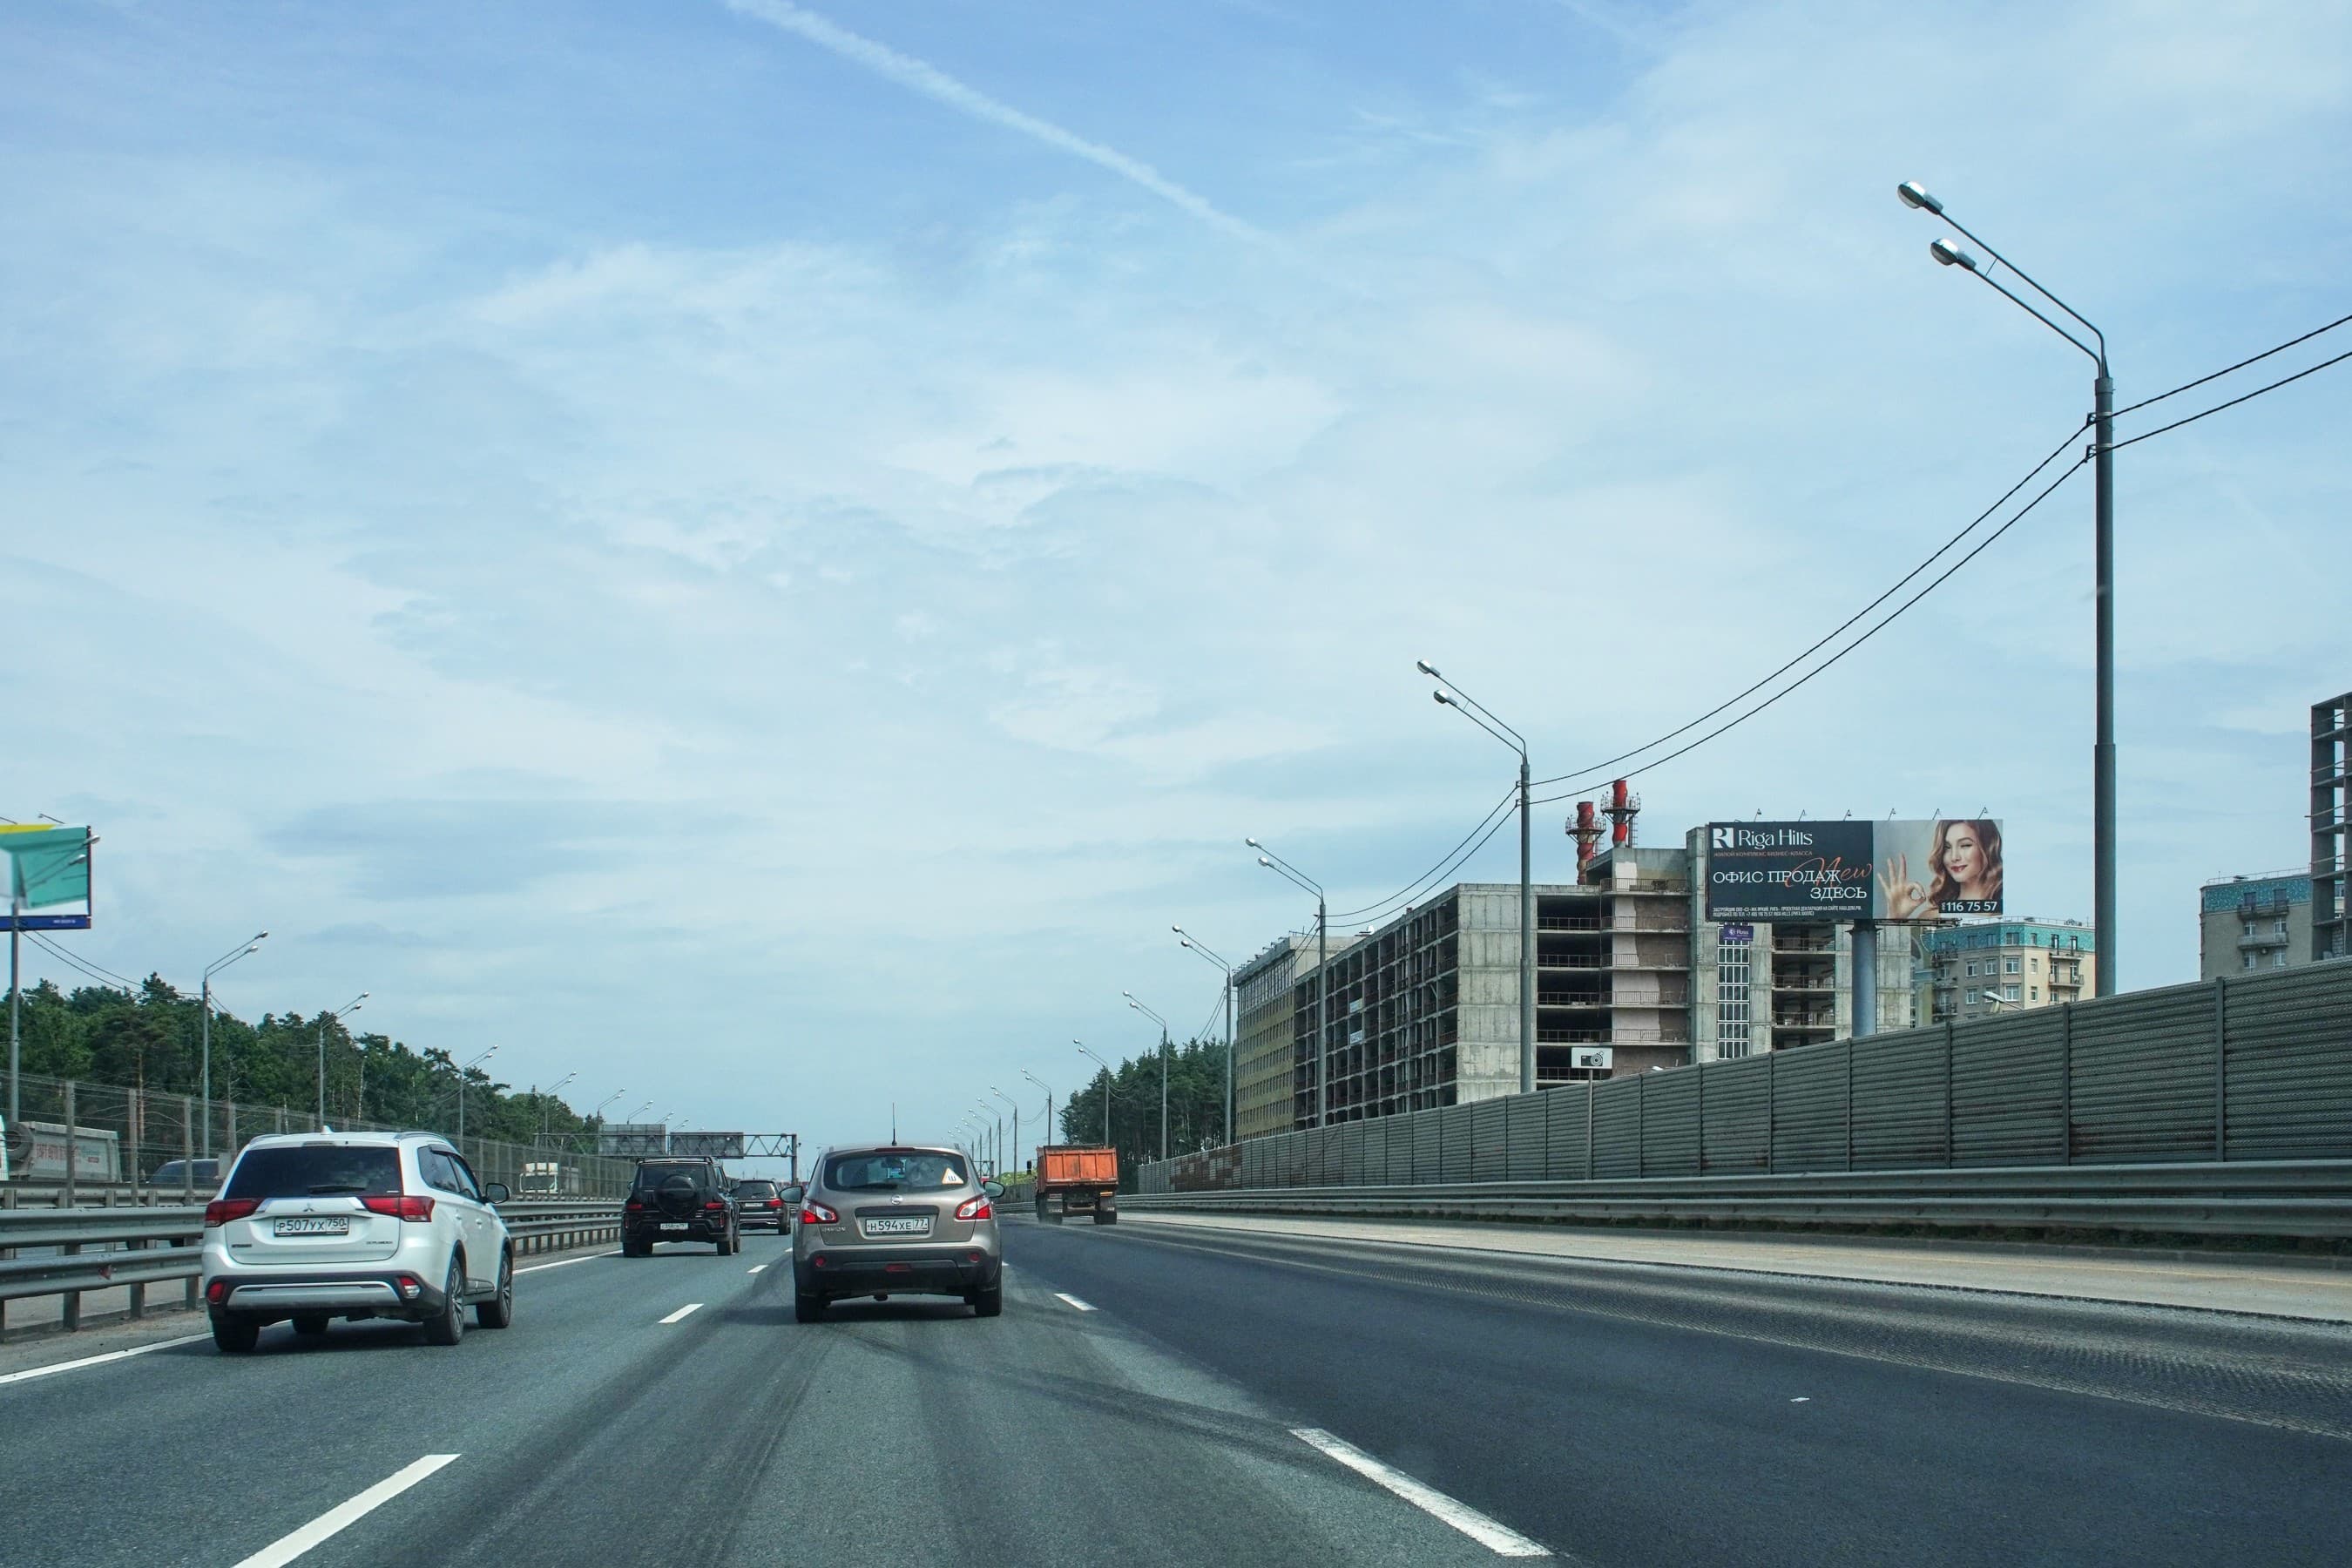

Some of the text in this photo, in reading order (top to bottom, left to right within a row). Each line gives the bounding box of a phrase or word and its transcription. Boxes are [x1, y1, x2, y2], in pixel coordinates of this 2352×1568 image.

[1739, 828, 1813, 849] Riga Hills
[1713, 870, 1842, 884] ОФИС ПРОДАЖ
[1810, 887, 1868, 902] ЗДЕСЬ
[1946, 902, 1964, 912] 116
[1966, 902, 1981, 911] 75
[1983, 901, 1997, 911] 57
[915, 1219, 924, 1227] 77
